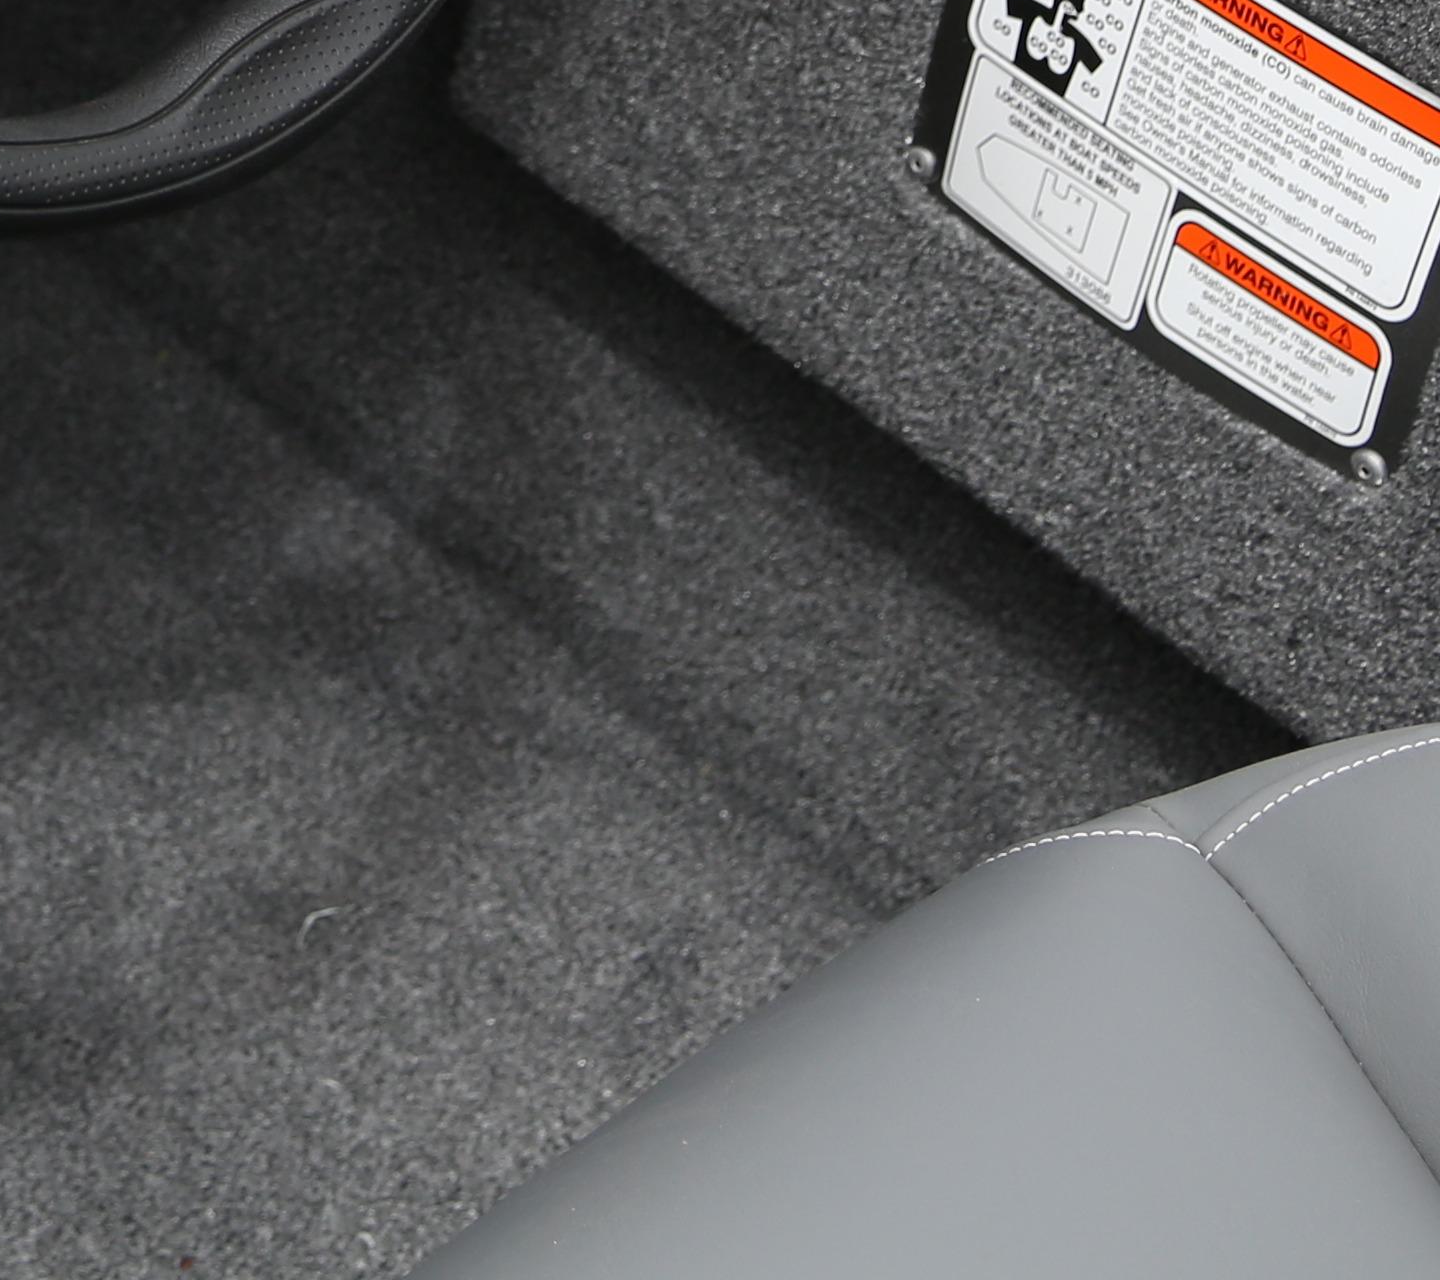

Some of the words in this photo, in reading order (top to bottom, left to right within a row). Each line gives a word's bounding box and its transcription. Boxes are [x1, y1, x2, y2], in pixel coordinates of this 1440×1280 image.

[1200, 15, 1258, 57] monoxide
[1261, 52, 1291, 78] (CO)
[1293, 74, 1315, 92] can
[1318, 89, 1354, 115] cause
[1356, 109, 1387, 135] brain
[1390, 132, 1440, 166] damage
[1225, 251, 1329, 332] WARNING
